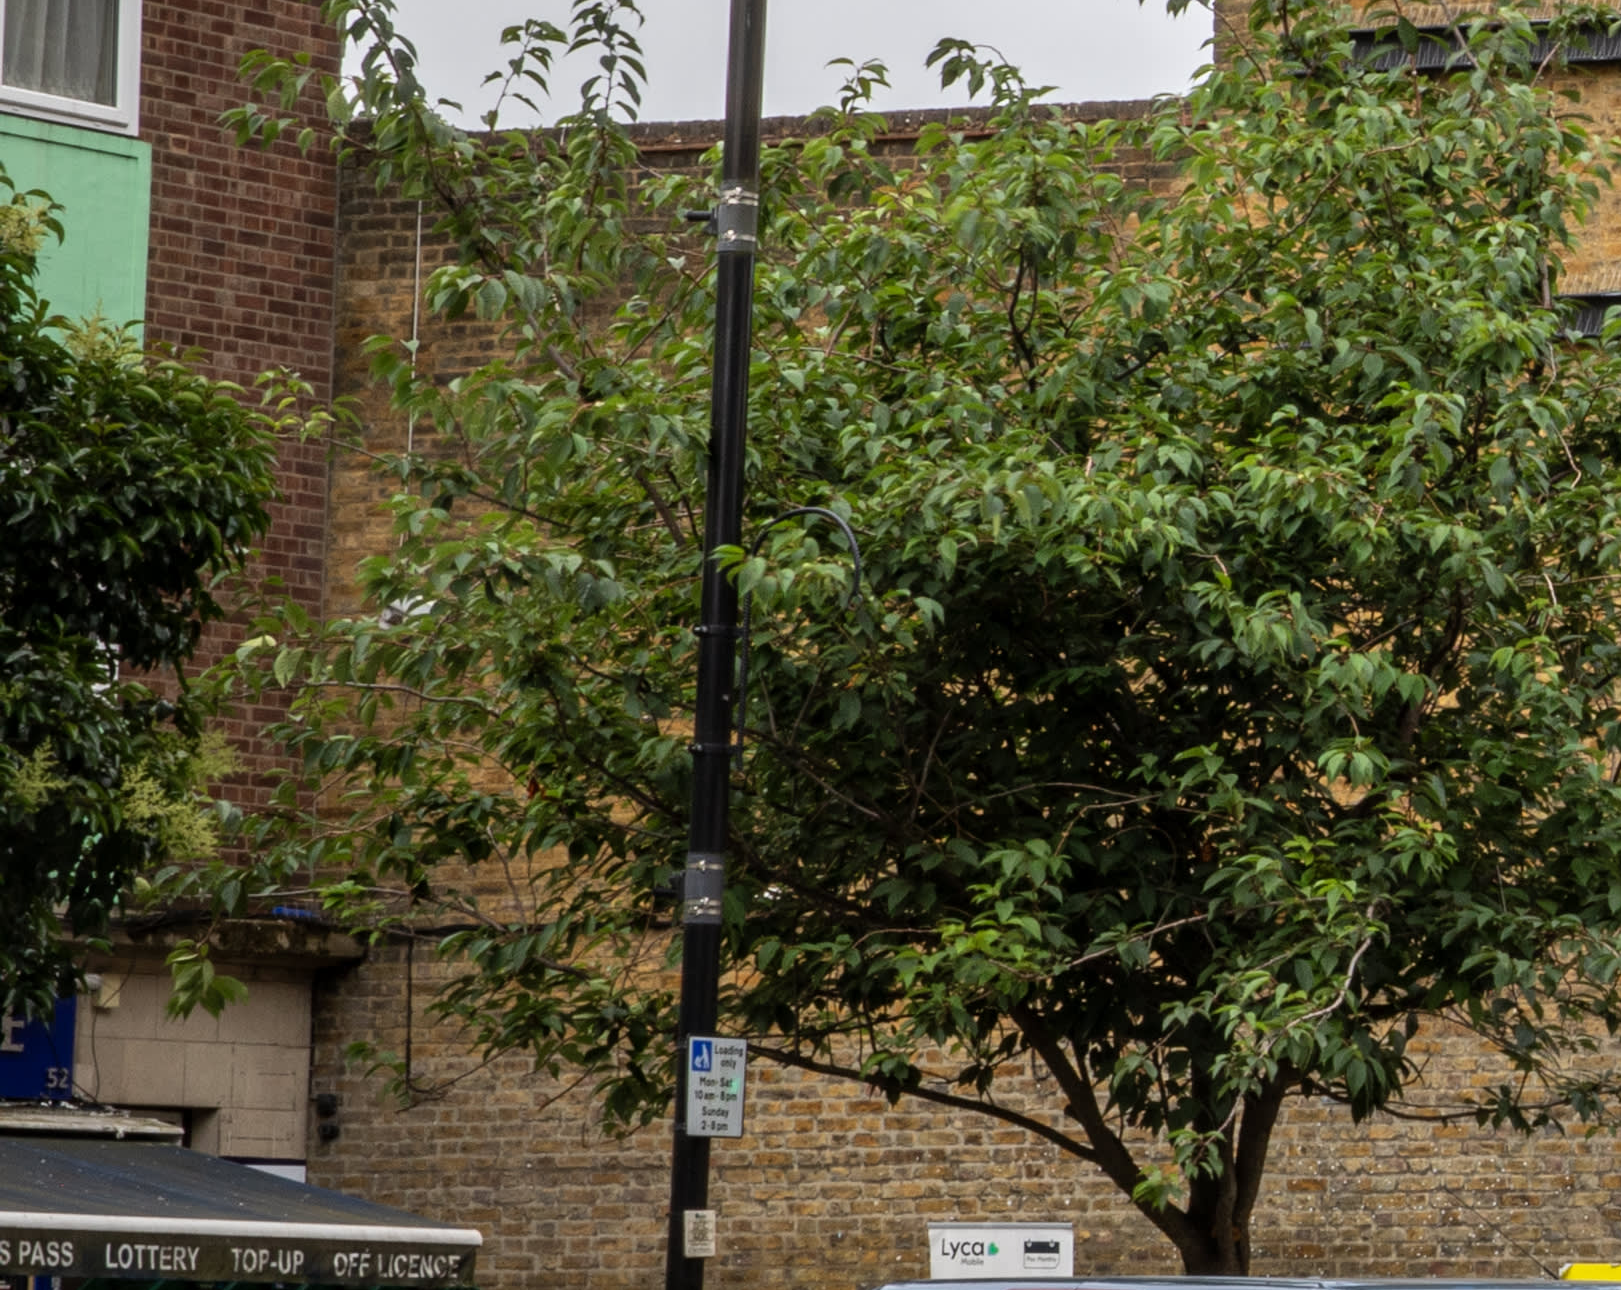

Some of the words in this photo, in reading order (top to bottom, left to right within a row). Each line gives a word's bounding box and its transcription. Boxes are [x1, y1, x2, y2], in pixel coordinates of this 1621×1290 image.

[714, 1045, 744, 1058] Loading
[720, 1059, 737, 1070] only
[46, 1068, 69, 1088] 52
[702, 1106, 729, 1118] Sunday
[18, 1242, 74, 1266] PASS
[105, 1243, 200, 1271] LOTTERY
[942, 1238, 984, 1259] Lyca
[230, 1246, 305, 1275] TOP-UP
[333, 1251, 370, 1277] OFF
[377, 1253, 461, 1279] LICENCE
